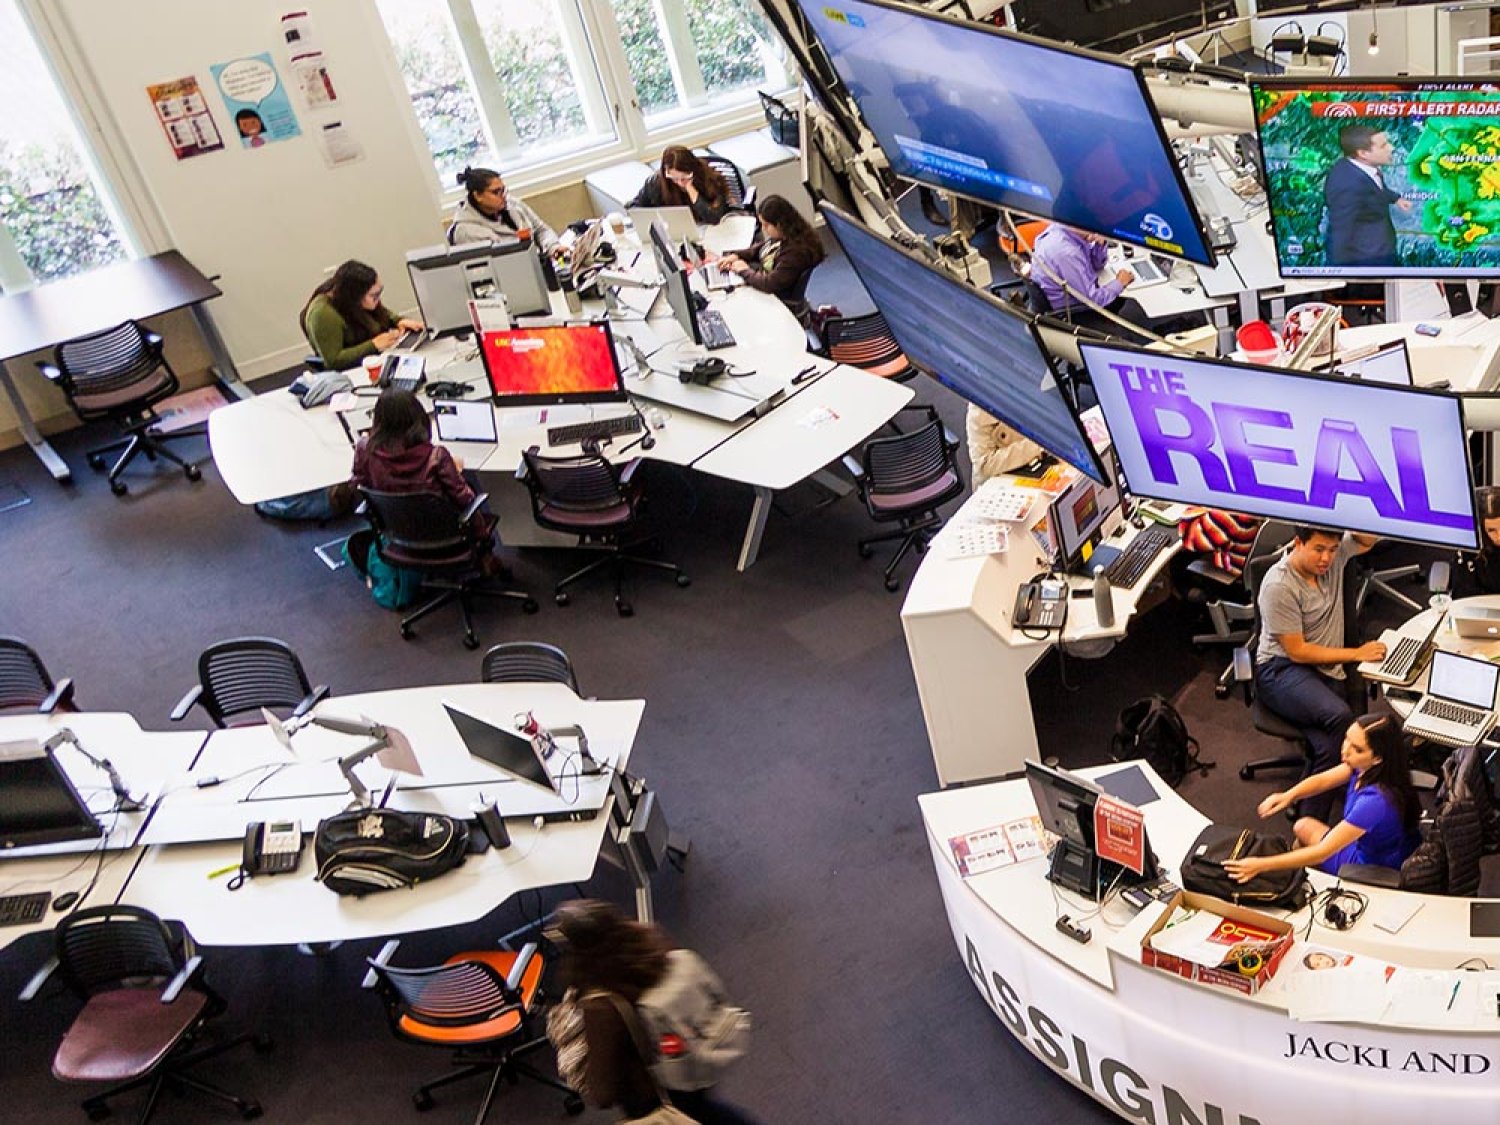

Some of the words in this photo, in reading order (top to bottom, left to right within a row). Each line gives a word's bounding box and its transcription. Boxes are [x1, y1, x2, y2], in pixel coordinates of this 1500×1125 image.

[1365, 103, 1404, 115] FIRST
[1407, 103, 1454, 115] ALERT
[1108, 363, 1189, 397] THE
[1127, 392, 1475, 531] REAL
[964, 933, 1262, 1125] ASSIGN
[1284, 1032, 1392, 1069] JACKI
[1401, 1051, 1491, 1075] AND
